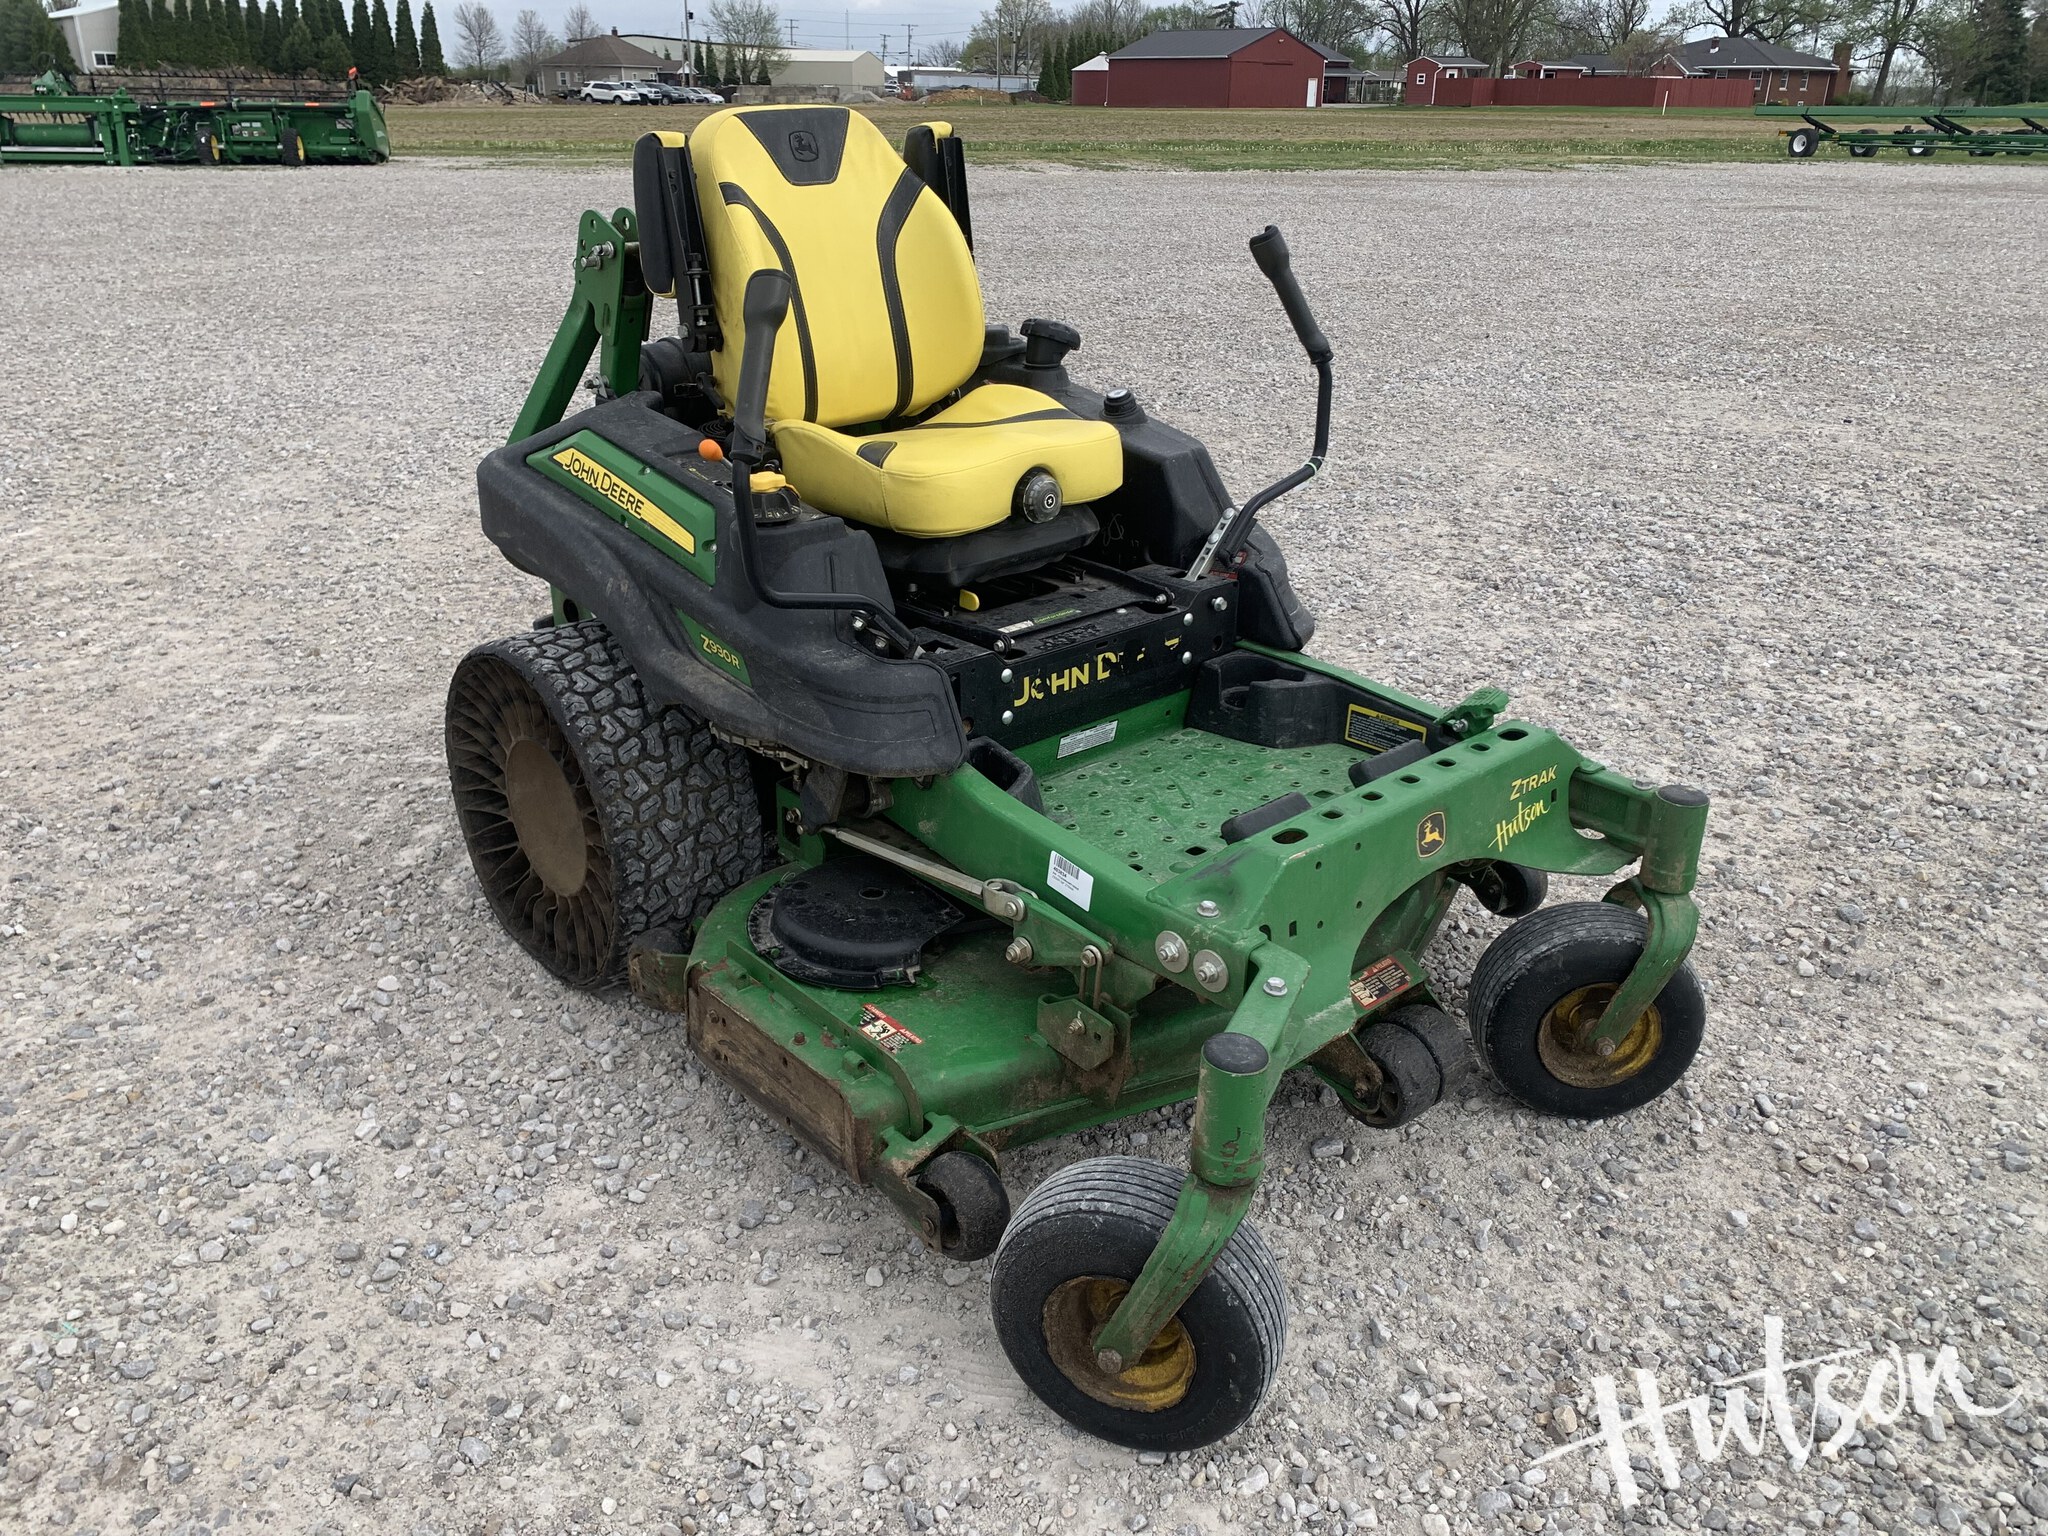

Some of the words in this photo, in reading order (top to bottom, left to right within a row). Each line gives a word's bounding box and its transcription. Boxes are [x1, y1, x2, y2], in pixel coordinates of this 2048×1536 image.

[564, 452, 600, 486] JOHN
[600, 472, 645, 517] DEERE
[700, 633, 741, 670] Z930R
[1509, 764, 1558, 801] ZTRAK
[1487, 799, 1552, 853] Hutson
